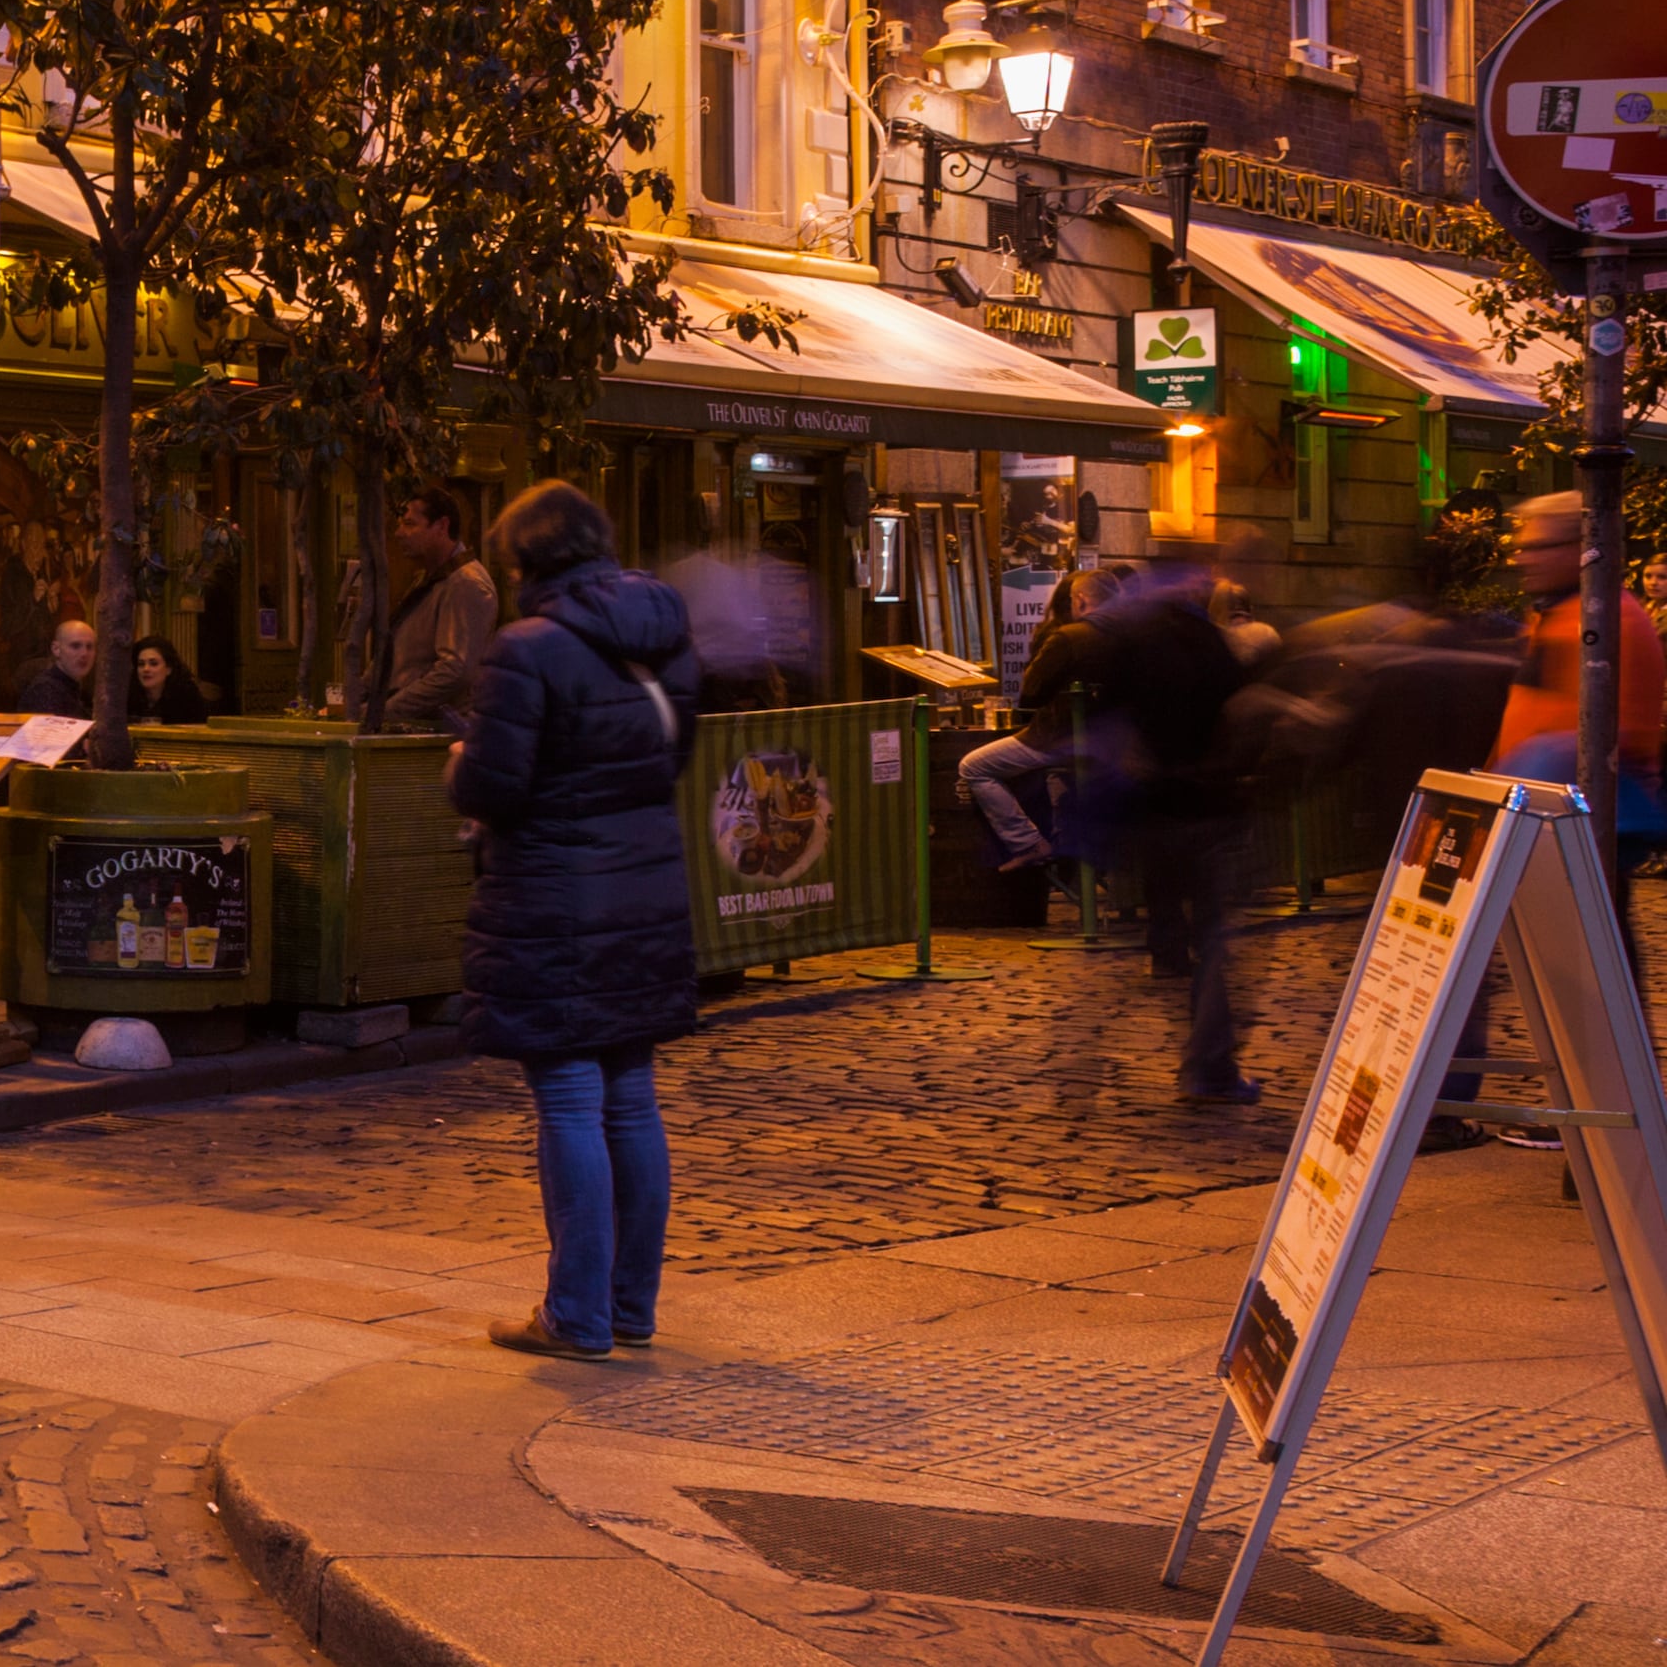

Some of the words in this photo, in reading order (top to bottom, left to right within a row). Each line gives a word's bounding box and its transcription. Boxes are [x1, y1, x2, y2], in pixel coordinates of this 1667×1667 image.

[1201, 152, 1292, 218] OLIVER
[1332, 180, 1396, 242] JOHN
[9, 279, 179, 359] OLIER
[1168, 384, 1184, 393] Pub
[706, 402, 731, 425] THE
[731, 402, 772, 426] OLIVER
[791, 408, 822, 429] OHN
[822, 409, 872, 433] GOGARTY
[1016, 603, 1044, 616] LIVE
[1002, 641, 1024, 655] ISH
[85, 847, 224, 890] GOGARTY'S
[716, 893, 744, 917] BEST
[745, 891, 769, 913] BAR
[769, 887, 795, 910] FOOD
[805, 881, 835, 903] TOWN
